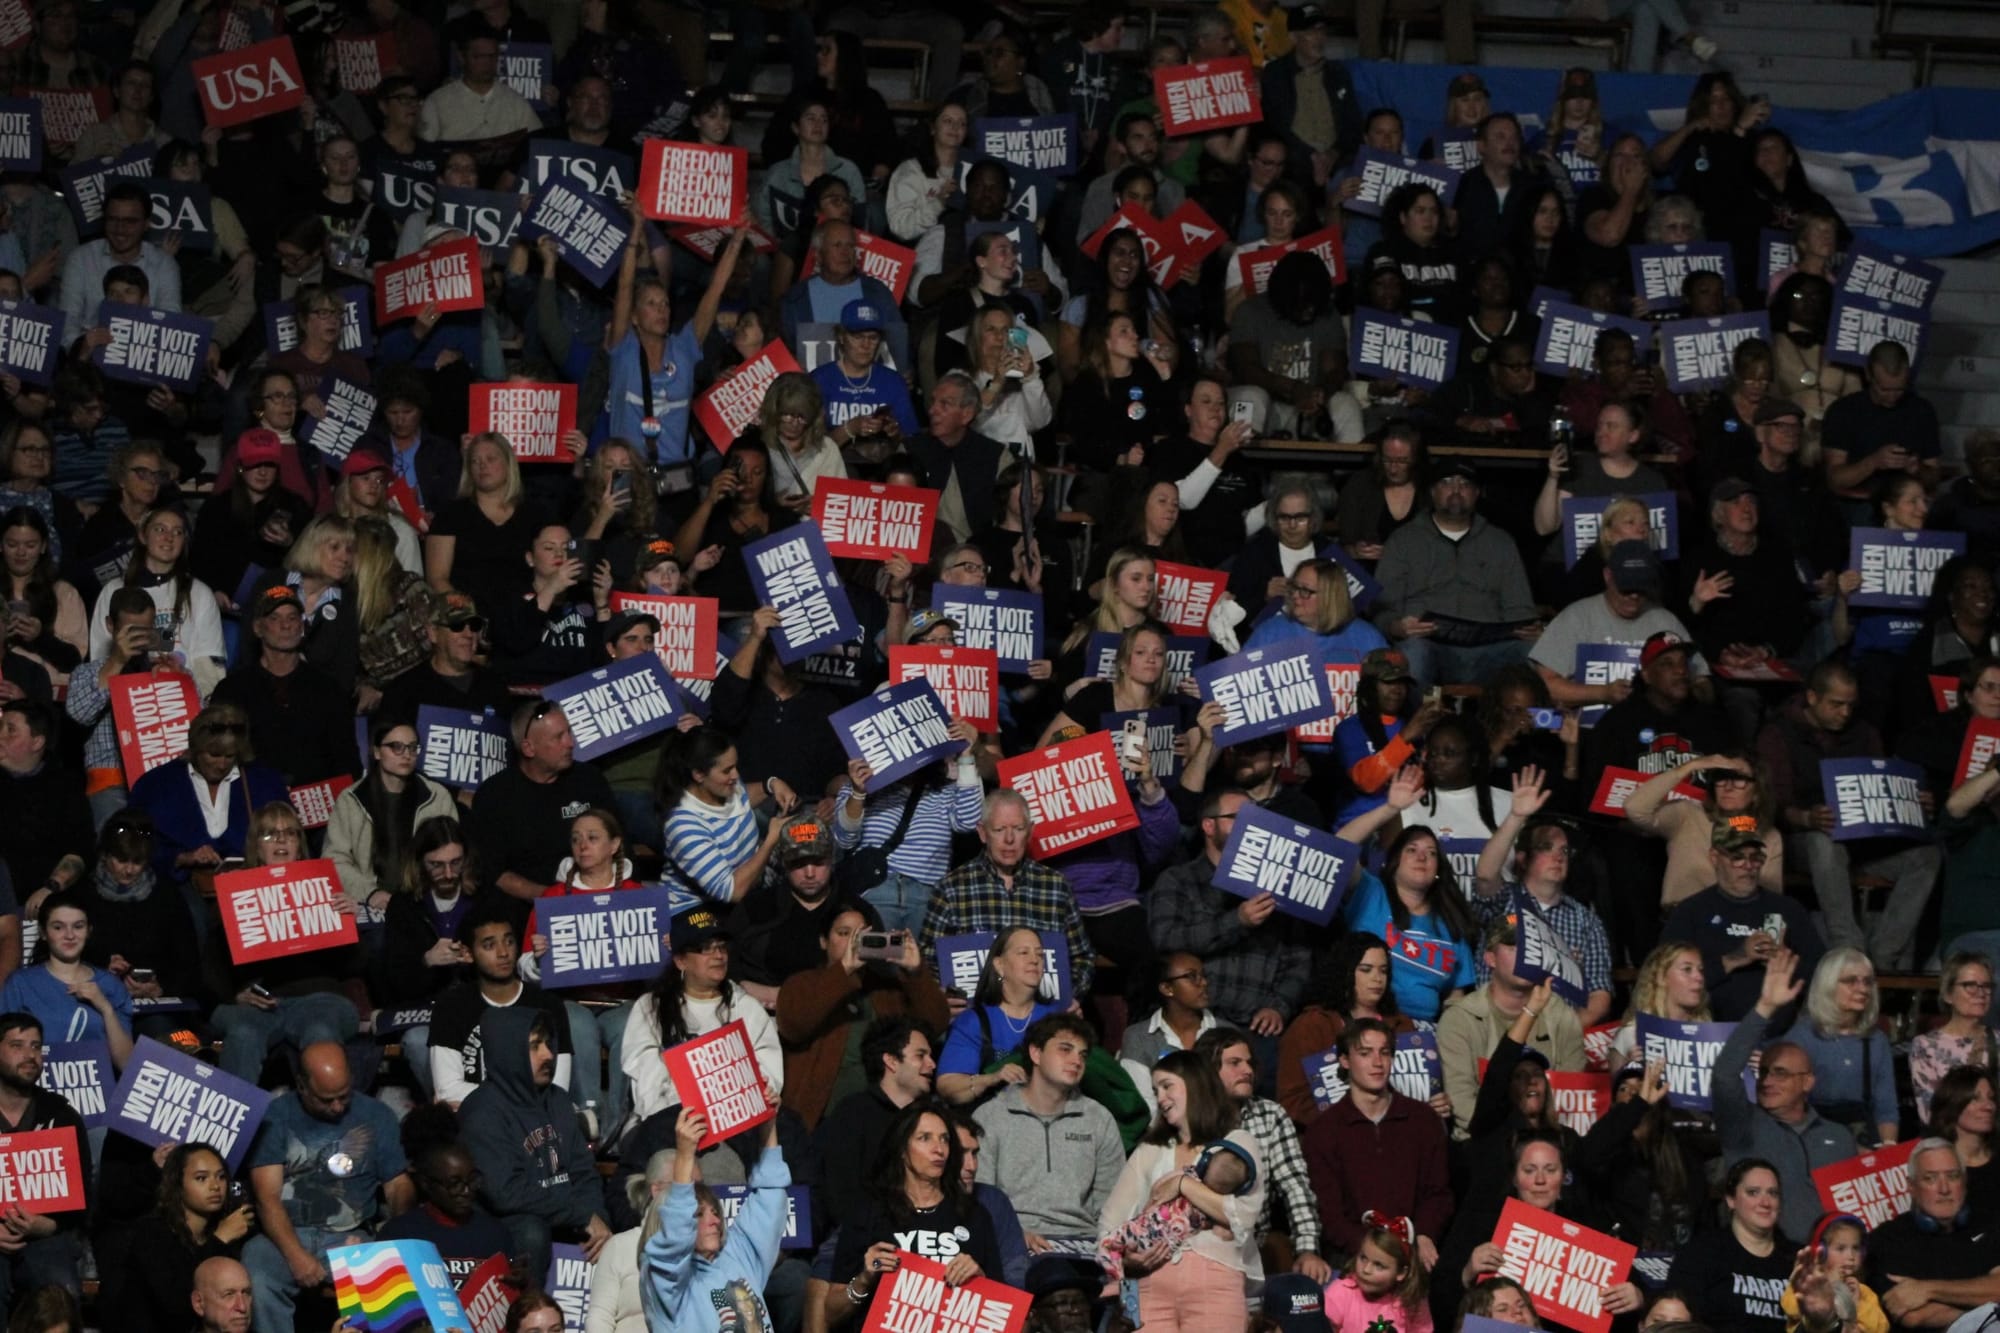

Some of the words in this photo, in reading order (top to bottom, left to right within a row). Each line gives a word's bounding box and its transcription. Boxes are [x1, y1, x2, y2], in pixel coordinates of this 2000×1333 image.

[201, 57, 299, 110] USA
[506, 57, 542, 77] VOTE
[1186, 76, 1214, 99] WE
[1211, 72, 1246, 95] VOTE
[1166, 80, 1191, 124] WHEN
[1189, 97, 1218, 121] WE
[1215, 92, 1249, 116] WIN
[1031, 128, 1067, 149] VOTE
[663, 146, 734, 176] FREEDOM
[1033, 147, 1066, 170] WIN
[73, 175, 104, 223] WHEN
[382, 172, 436, 213] US
[659, 165, 733, 198] FREEDOM
[1355, 160, 1385, 203] WHEN
[149, 193, 208, 232] SA
[531, 204, 569, 240] VOTE
[540, 188, 579, 222] WIN
[569, 206, 605, 239] WE
[656, 192, 732, 220] FREEDOM
[560, 224, 593, 256] WE
[584, 222, 626, 270] WHEN
[404, 263, 432, 288] WE
[430, 254, 470, 282] VOTE
[1641, 257, 1667, 300] WHEN
[1661, 256, 1686, 276] WE
[1872, 262, 1898, 284] WE
[1895, 270, 1932, 300] VOTE
[385, 269, 406, 313] WHEN
[405, 283, 434, 309] WE
[433, 276, 471, 303] WIN
[12, 315, 53, 348] VOTE
[104, 316, 132, 367] WHEN
[129, 320, 160, 349] WE
[156, 326, 200, 357] VOTE
[1361, 321, 1384, 367] WHEN
[1383, 326, 1411, 352] WE
[1409, 332, 1448, 361] VOTE
[1544, 317, 1575, 364] WHEN
[1695, 332, 1721, 355] WE
[1836, 306, 1862, 352] WHEN
[1861, 311, 1887, 337] WE
[1887, 316, 1921, 344] VOTE
[9, 338, 48, 373] WIN
[124, 345, 157, 373] WE
[153, 351, 195, 381] WIN
[1380, 348, 1410, 374] WE
[1407, 354, 1445, 382] WIN
[1673, 335, 1699, 382] WHEN
[1698, 354, 1727, 379] WE
[1960, 359, 1976, 372] 16
[489, 389, 561, 412] FREEDOM
[709, 355, 777, 411] FREEDOM
[489, 410, 558, 435] FREEDOM
[823, 494, 849, 543] WHEN
[848, 496, 881, 522] WE
[879, 499, 924, 526] VOTE
[846, 521, 880, 546] WE
[878, 524, 921, 549] WIN
[756, 537, 813, 580] WHEN
[1860, 544, 1885, 593] WHEN
[1885, 546, 1913, 569] WE
[766, 571, 801, 611] WE
[791, 560, 824, 599] WE
[1884, 569, 1915, 596] WE
[802, 589, 839, 637] VOTE
[967, 603, 995, 630] WE
[996, 606, 1034, 634] VOTE
[1183, 581, 1215, 627] WHEN
[779, 601, 816, 648] WIN
[996, 632, 1034, 661] WIN
[810, 655, 861, 678] WALZ
[954, 666, 989, 691] VOTE
[1236, 667, 1274, 700] WE
[1268, 655, 1316, 691] VOTE
[128, 683, 161, 730] VOTE
[153, 680, 188, 723] WIN
[586, 682, 625, 715] WE
[617, 669, 663, 703] VOTE
[957, 691, 990, 719] WIN
[1242, 693, 1281, 726] WE
[1276, 682, 1321, 716] WIN
[560, 693, 604, 749] WHEN
[595, 705, 636, 739] WE
[628, 691, 672, 726] WIN
[874, 707, 910, 743] WE
[903, 695, 943, 732] VOTE
[138, 728, 165, 758] WE
[422, 725, 449, 780] WHEN
[446, 728, 478, 757] WE
[884, 733, 919, 767] WE
[912, 720, 948, 755] WIN
[1146, 725, 1176, 751] VOTE
[442, 755, 478, 784] WE
[1034, 763, 1070, 795] WE
[1063, 752, 1111, 788] VOTE
[1042, 789, 1079, 819] WE
[1073, 780, 1117, 812] WIN
[1835, 776, 1862, 827] WHEN
[1857, 777, 1886, 802] WE
[1884, 778, 1921, 803] VOTE
[1860, 803, 1890, 827] WE
[1888, 804, 1924, 827] WIN
[1229, 824, 1273, 886] WHEN
[1265, 833, 1304, 869] WE
[1295, 844, 1344, 883] VOTE
[259, 884, 296, 915] WE
[291, 878, 338, 910] VOTE
[1254, 860, 1296, 897] WE
[1287, 872, 1335, 910] WIN
[232, 888, 268, 949] WHEN
[263, 912, 302, 944] WE
[298, 905, 342, 938] WIN
[575, 912, 610, 942] WE
[608, 907, 657, 939] VOTE
[550, 916, 578, 973] WHEN
[577, 941, 614, 971] WE
[612, 936, 659, 967] WIN
[1384, 922, 1456, 972] VOTE
[685, 1029, 749, 1078] FREEDOM
[1665, 1041, 1697, 1067] WE
[50, 1060, 101, 1088] VOTE
[697, 1057, 759, 1106] FREEDOM
[1666, 1067, 1698, 1098] WE
[122, 1060, 169, 1129] WHEN
[160, 1073, 205, 1114] WE
[194, 1088, 249, 1132] VOTE
[706, 1083, 768, 1134] FREEDOM
[149, 1103, 194, 1142] WE
[12, 1147, 66, 1175] VOTE
[20, 1171, 69, 1201] WIN
[1852, 1172, 1886, 1204] WE
[893, 1230, 961, 1256] YES
[1498, 1223, 1536, 1287] WHEN
[1529, 1231, 1569, 1270] WE
[1561, 1243, 1617, 1288] VOTE
[421, 1262, 451, 1289] OUT
[891, 1268, 945, 1313] WIN
[1521, 1260, 1562, 1300] WE
[1555, 1273, 1608, 1318] WIN
[464, 1275, 503, 1326] VOTE
[1745, 1297, 1788, 1320] WAL
